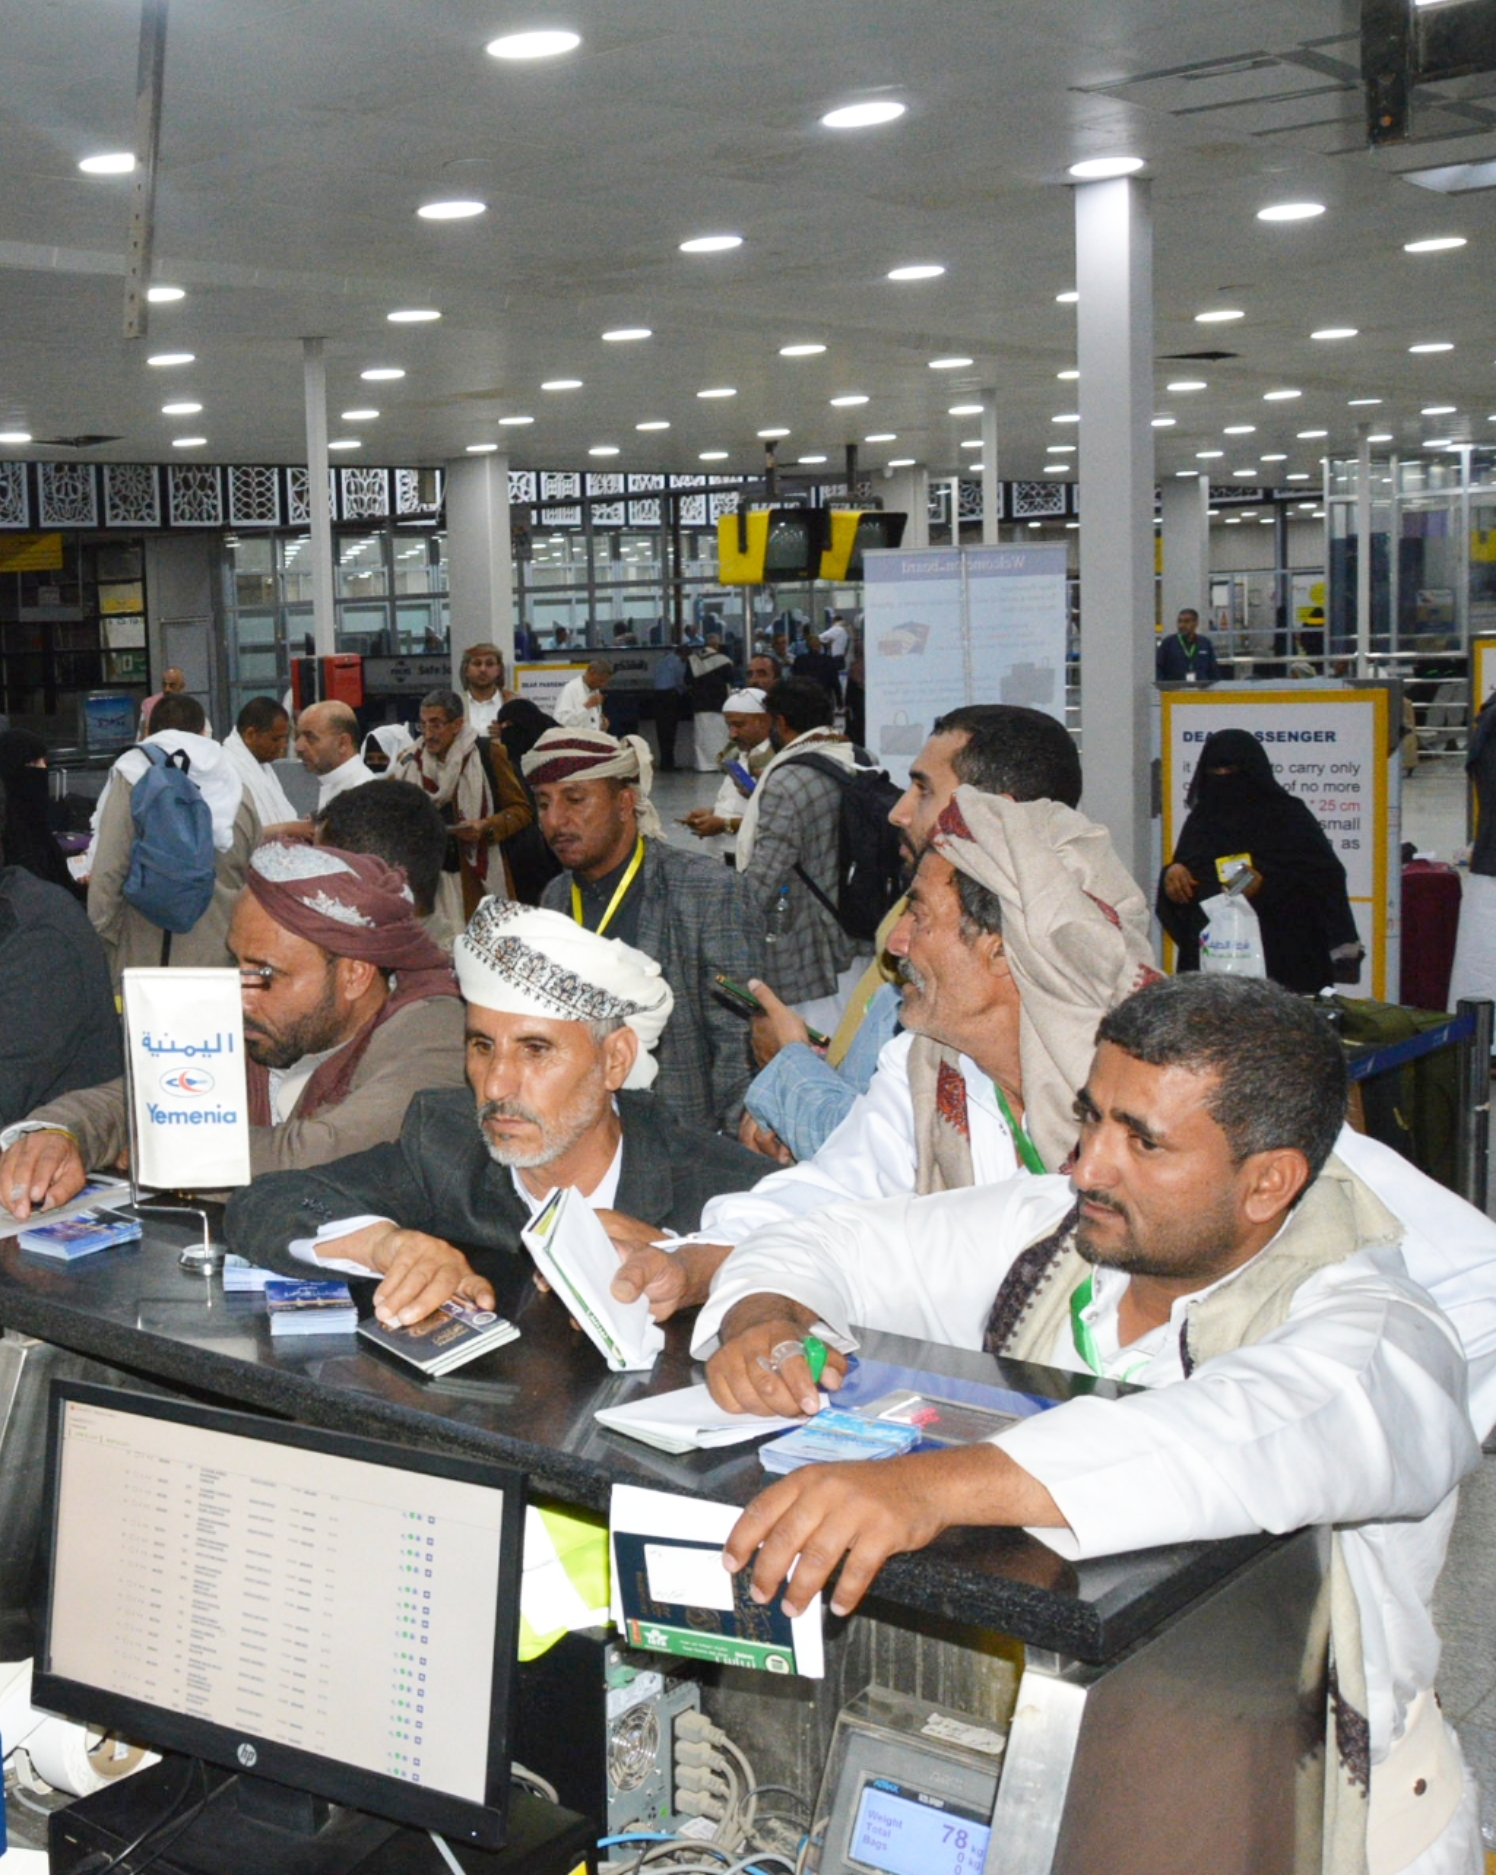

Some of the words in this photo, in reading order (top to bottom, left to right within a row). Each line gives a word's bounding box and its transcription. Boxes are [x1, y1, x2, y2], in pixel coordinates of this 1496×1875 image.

[1183, 731, 1212, 742] DEA
[1255, 731, 1336, 742] SSENGER
[1289, 764, 1325, 776] carry
[1330, 761, 1361, 776] only
[1300, 782, 1319, 792] no
[1323, 782, 1361, 792] more
[1319, 801, 1336, 812] 25
[1340, 803, 1361, 812] cm
[1341, 840, 1361, 850] as
[142, 1031, 234, 1058] اليمنية
[146, 1102, 237, 1125] Yemenia
[238, 1743, 257, 1767] hp
[868, 1810, 902, 1829] Weight
[941, 1824, 969, 1849] 78
[971, 1844, 984, 1859] kg
[862, 1835, 888, 1851] Bags
[866, 1822, 892, 1838] Total
[968, 1858, 981, 1872] kg
